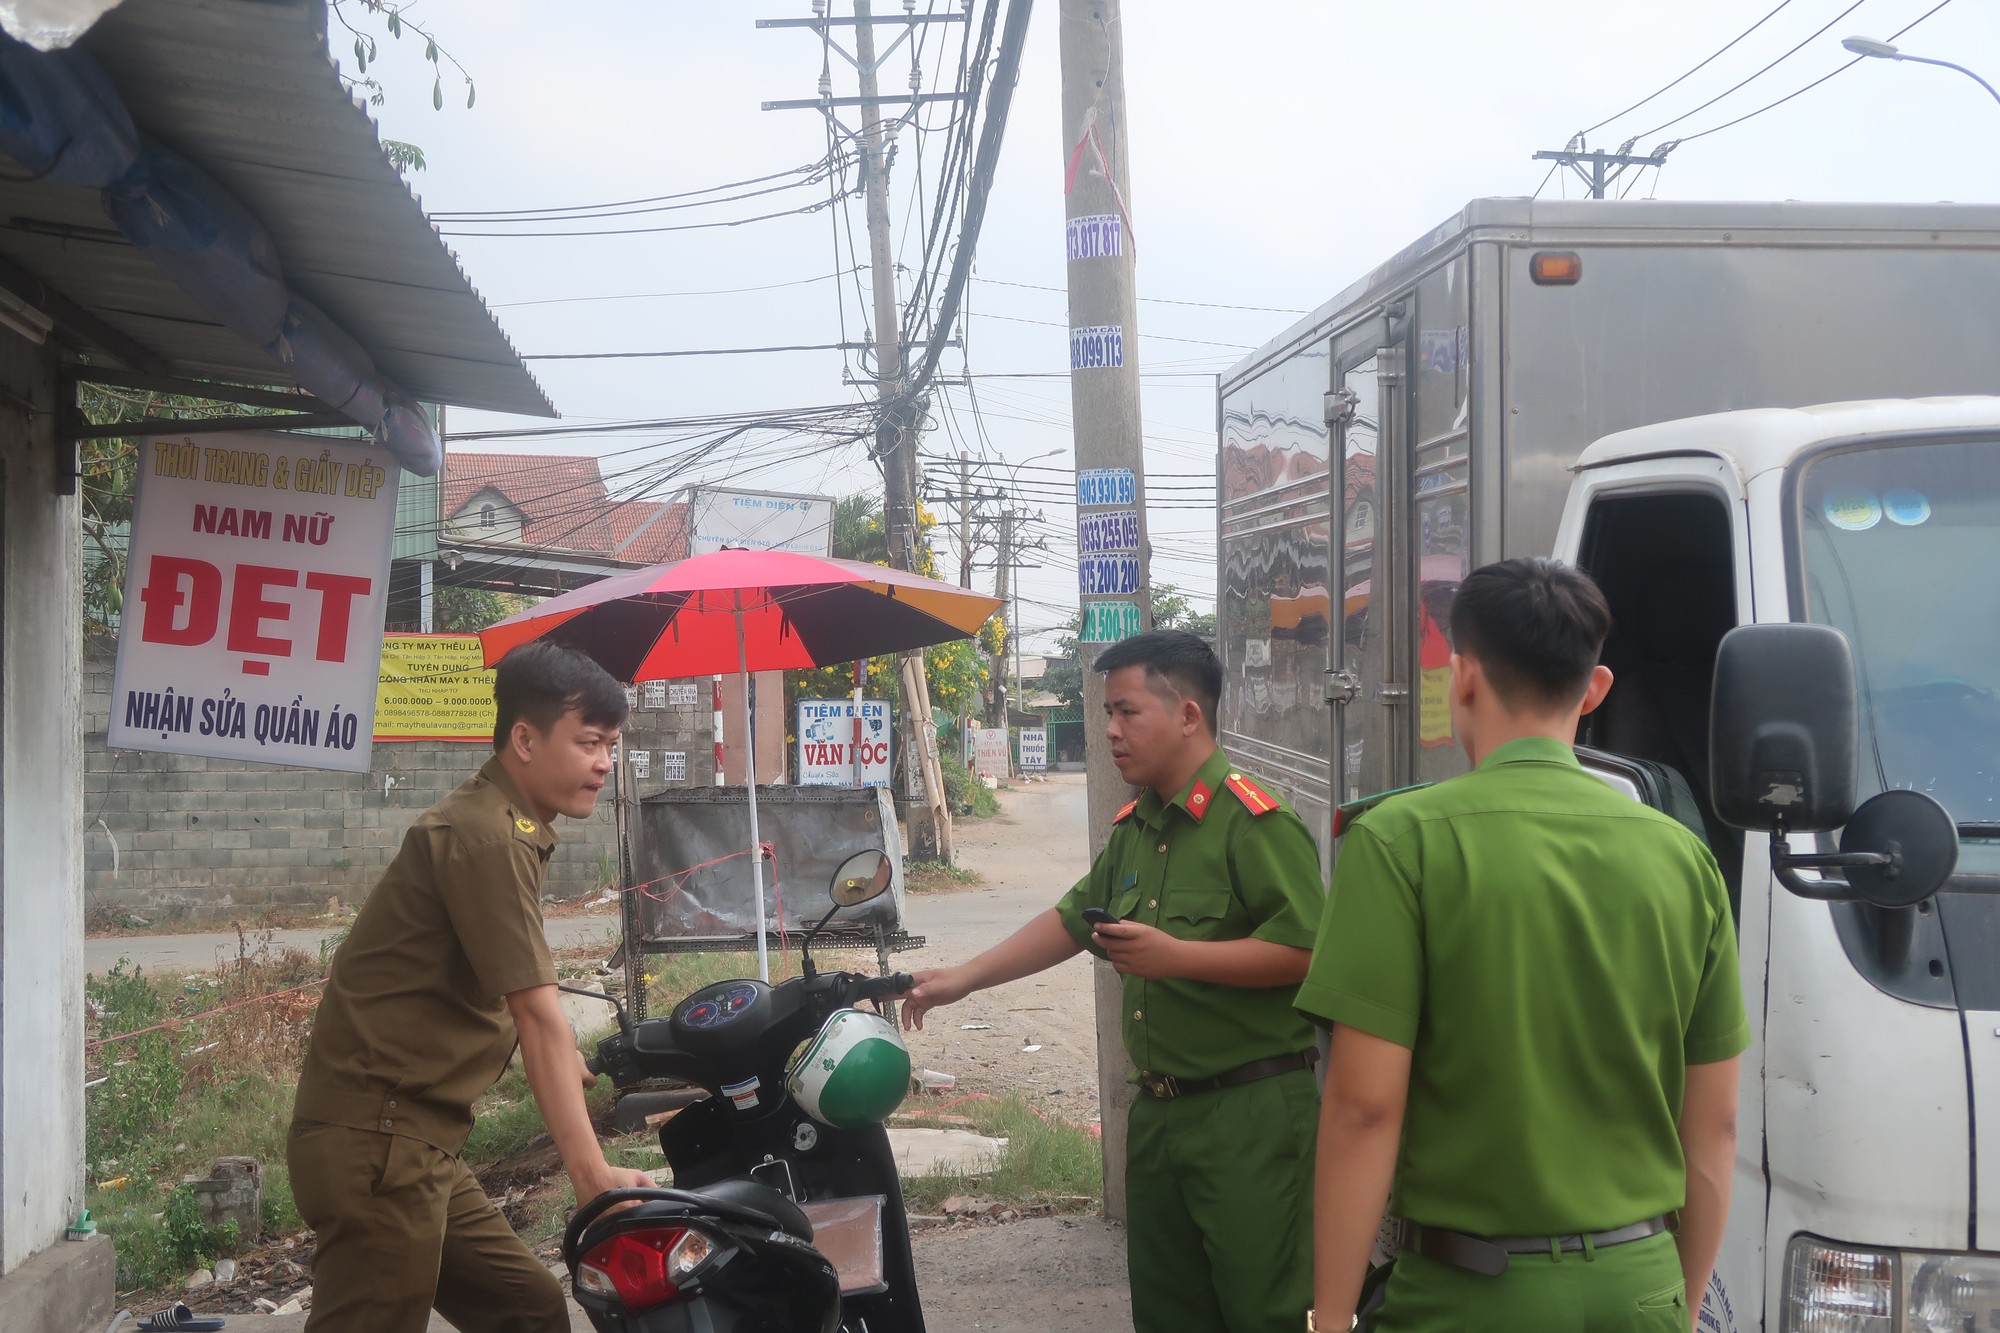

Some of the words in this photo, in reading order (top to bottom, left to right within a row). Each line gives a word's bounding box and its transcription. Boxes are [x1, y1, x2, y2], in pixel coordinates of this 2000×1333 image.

[154, 437, 200, 480] THỜI
[204, 448, 270, 487] TRANG
[272, 455, 290, 490] &
[344, 458, 385, 499] DÉP
[1079, 476, 1135, 504] 0903.930.950
[733, 497, 762, 508] TIỆM
[192, 503, 272, 540] NAM
[282, 511, 335, 546] NỮ
[140, 554, 372, 676] ĐẸT
[402, 642, 414, 650] TY
[441, 641, 465, 651] THÊU
[379, 675, 407, 684] CÔNG
[439, 676, 460, 684] MAY
[462, 676, 470, 684] &
[384, 697, 433, 705] 6.000.000Đ
[443, 697, 492, 706] 9.000.000Đ
[804, 703, 841, 720] TIỆM
[846, 702, 882, 720] ĐỆN
[124, 686, 194, 740] NHẬN
[199, 687, 246, 739] SỬA
[253, 694, 321, 746] QUẦN
[325, 703, 358, 751] ÁO
[396, 721, 497, 731] maytheulavang@gmail.c
[1023, 733, 1044, 741] NHÀ
[804, 738, 844, 765] VĂN
[1025, 756, 1042, 764] TÂY
